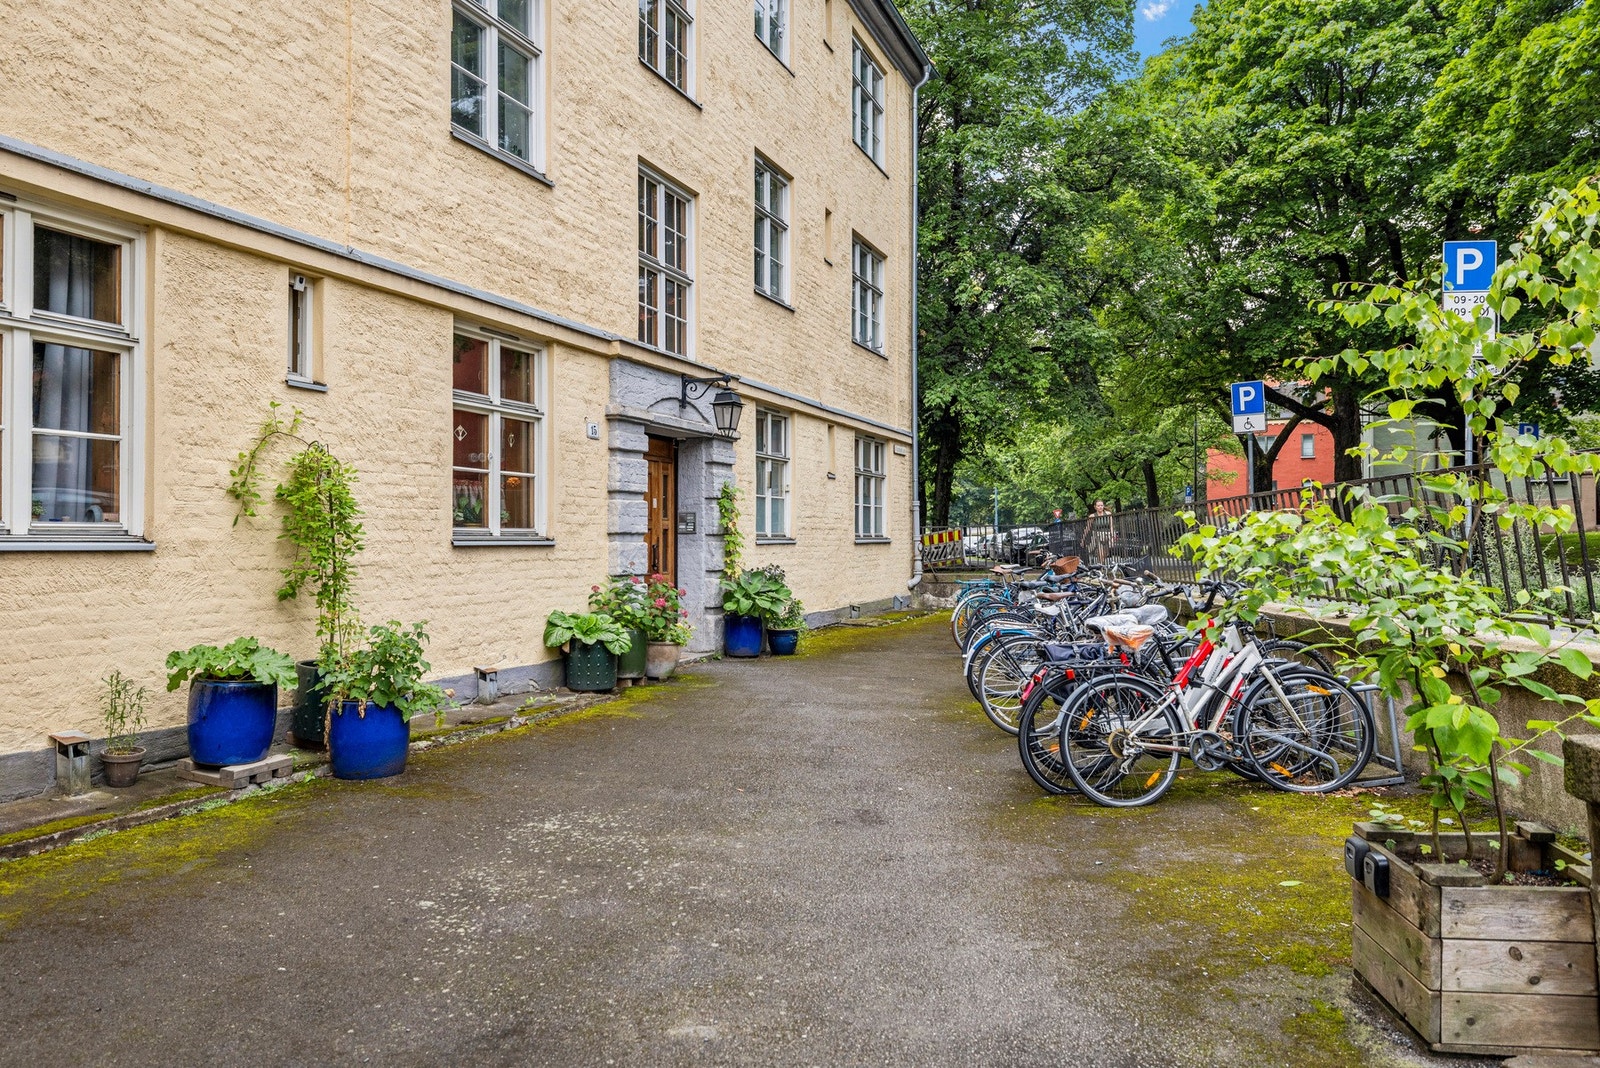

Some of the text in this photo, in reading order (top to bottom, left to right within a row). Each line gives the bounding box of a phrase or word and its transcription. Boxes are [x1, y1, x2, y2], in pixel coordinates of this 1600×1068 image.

[1456, 248, 1484, 285] P
[1239, 386, 1256, 412] P
[590, 425, 598, 436] 15
[1186, 487, 1191, 496] P
